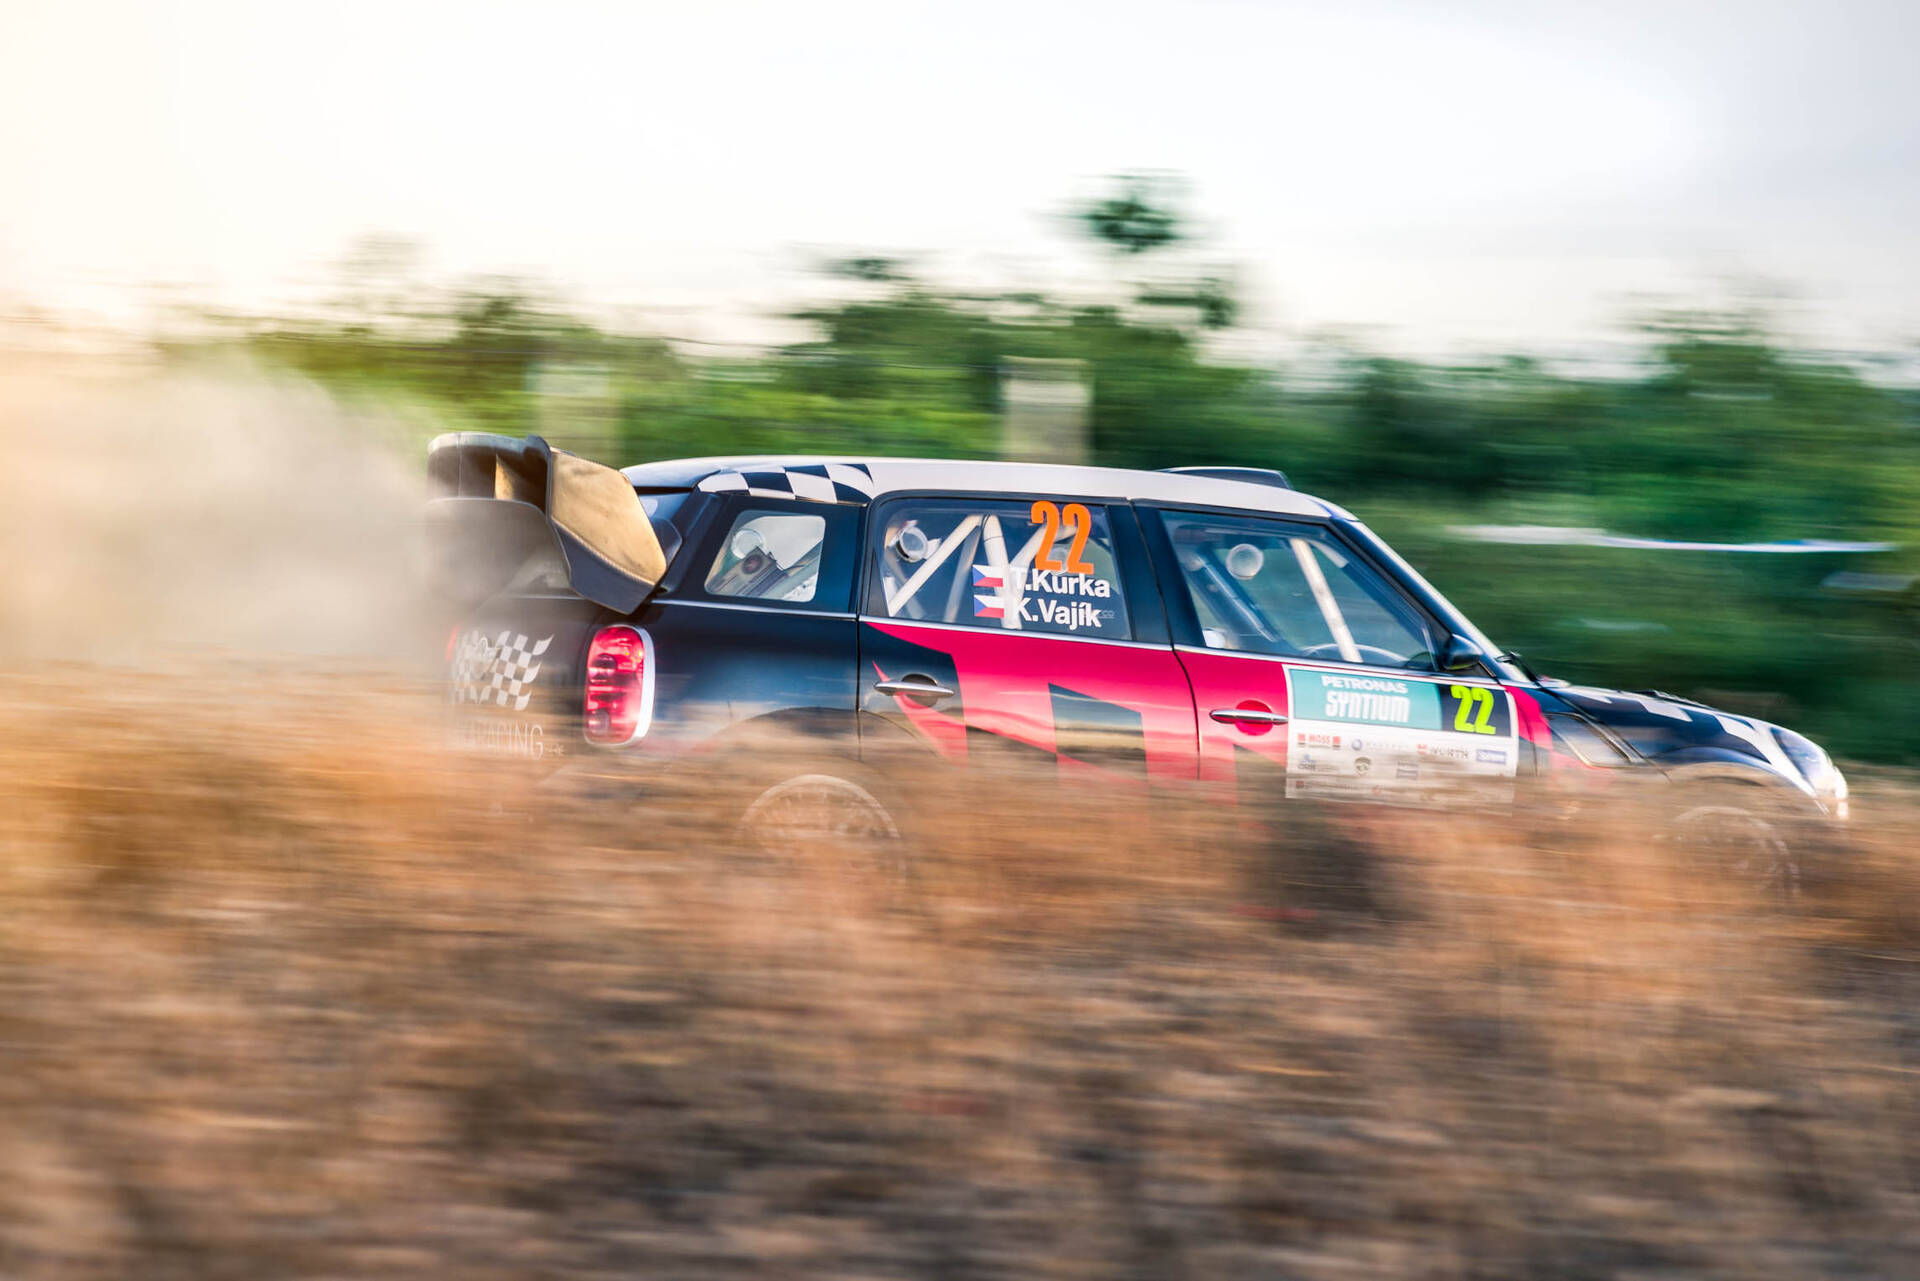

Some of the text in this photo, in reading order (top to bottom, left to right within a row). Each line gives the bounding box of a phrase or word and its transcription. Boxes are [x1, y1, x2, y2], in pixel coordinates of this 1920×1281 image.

[1030, 500, 1095, 575] 22
[1010, 566, 1111, 598] T.Kurka
[1014, 597, 1102, 631] K.Vajík
[1320, 675, 1409, 694] PETRONAS
[1325, 690, 1411, 723] SYNTIUM
[1450, 684, 1496, 735] 22
